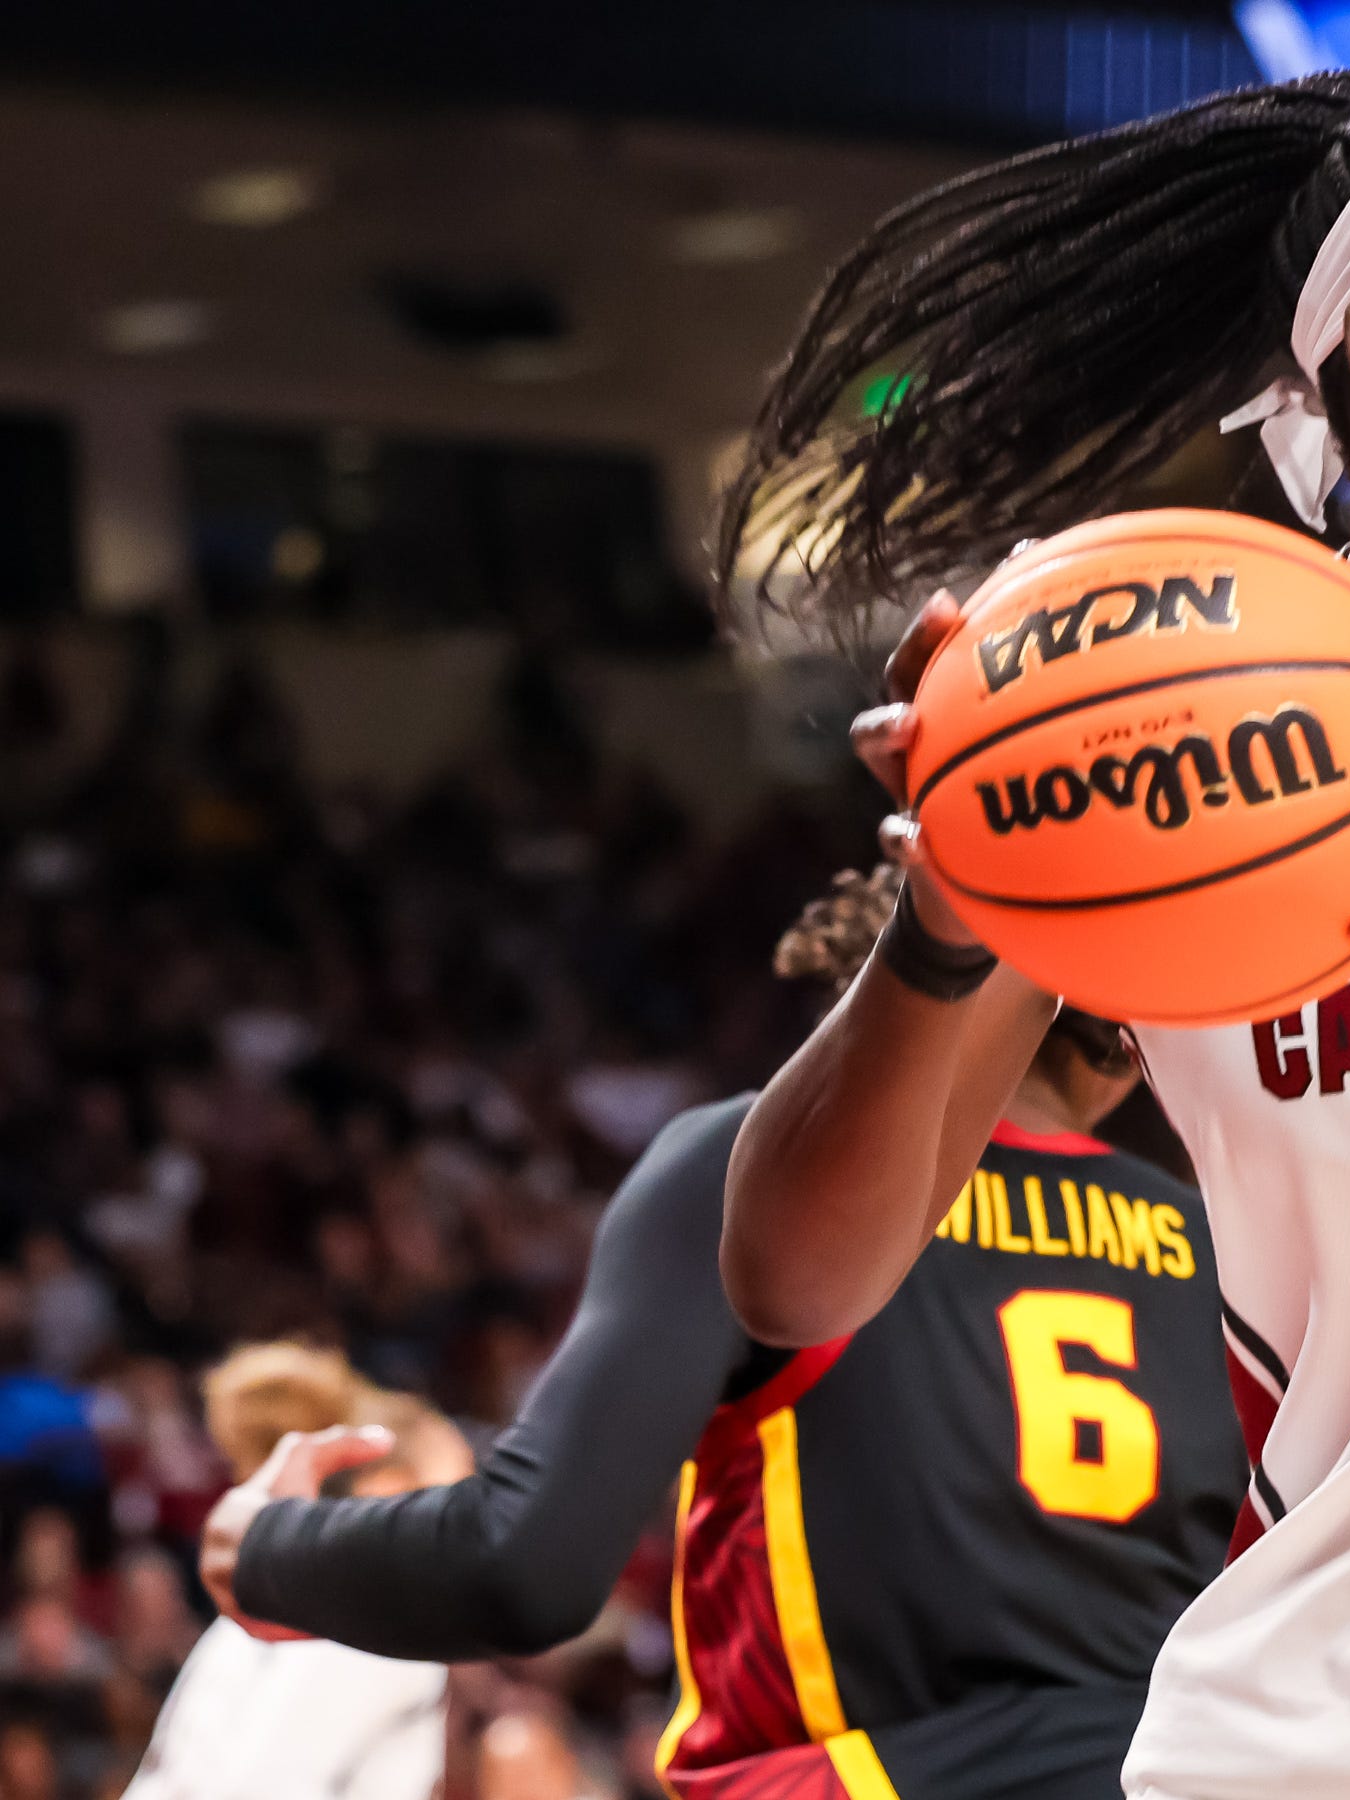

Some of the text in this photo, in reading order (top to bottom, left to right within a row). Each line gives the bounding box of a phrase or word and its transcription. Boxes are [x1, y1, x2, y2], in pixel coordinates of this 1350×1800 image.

[979, 574, 1237, 693] NCAA
[976, 707, 1347, 835] Wilson
[997, 1288, 1161, 1525] 6
